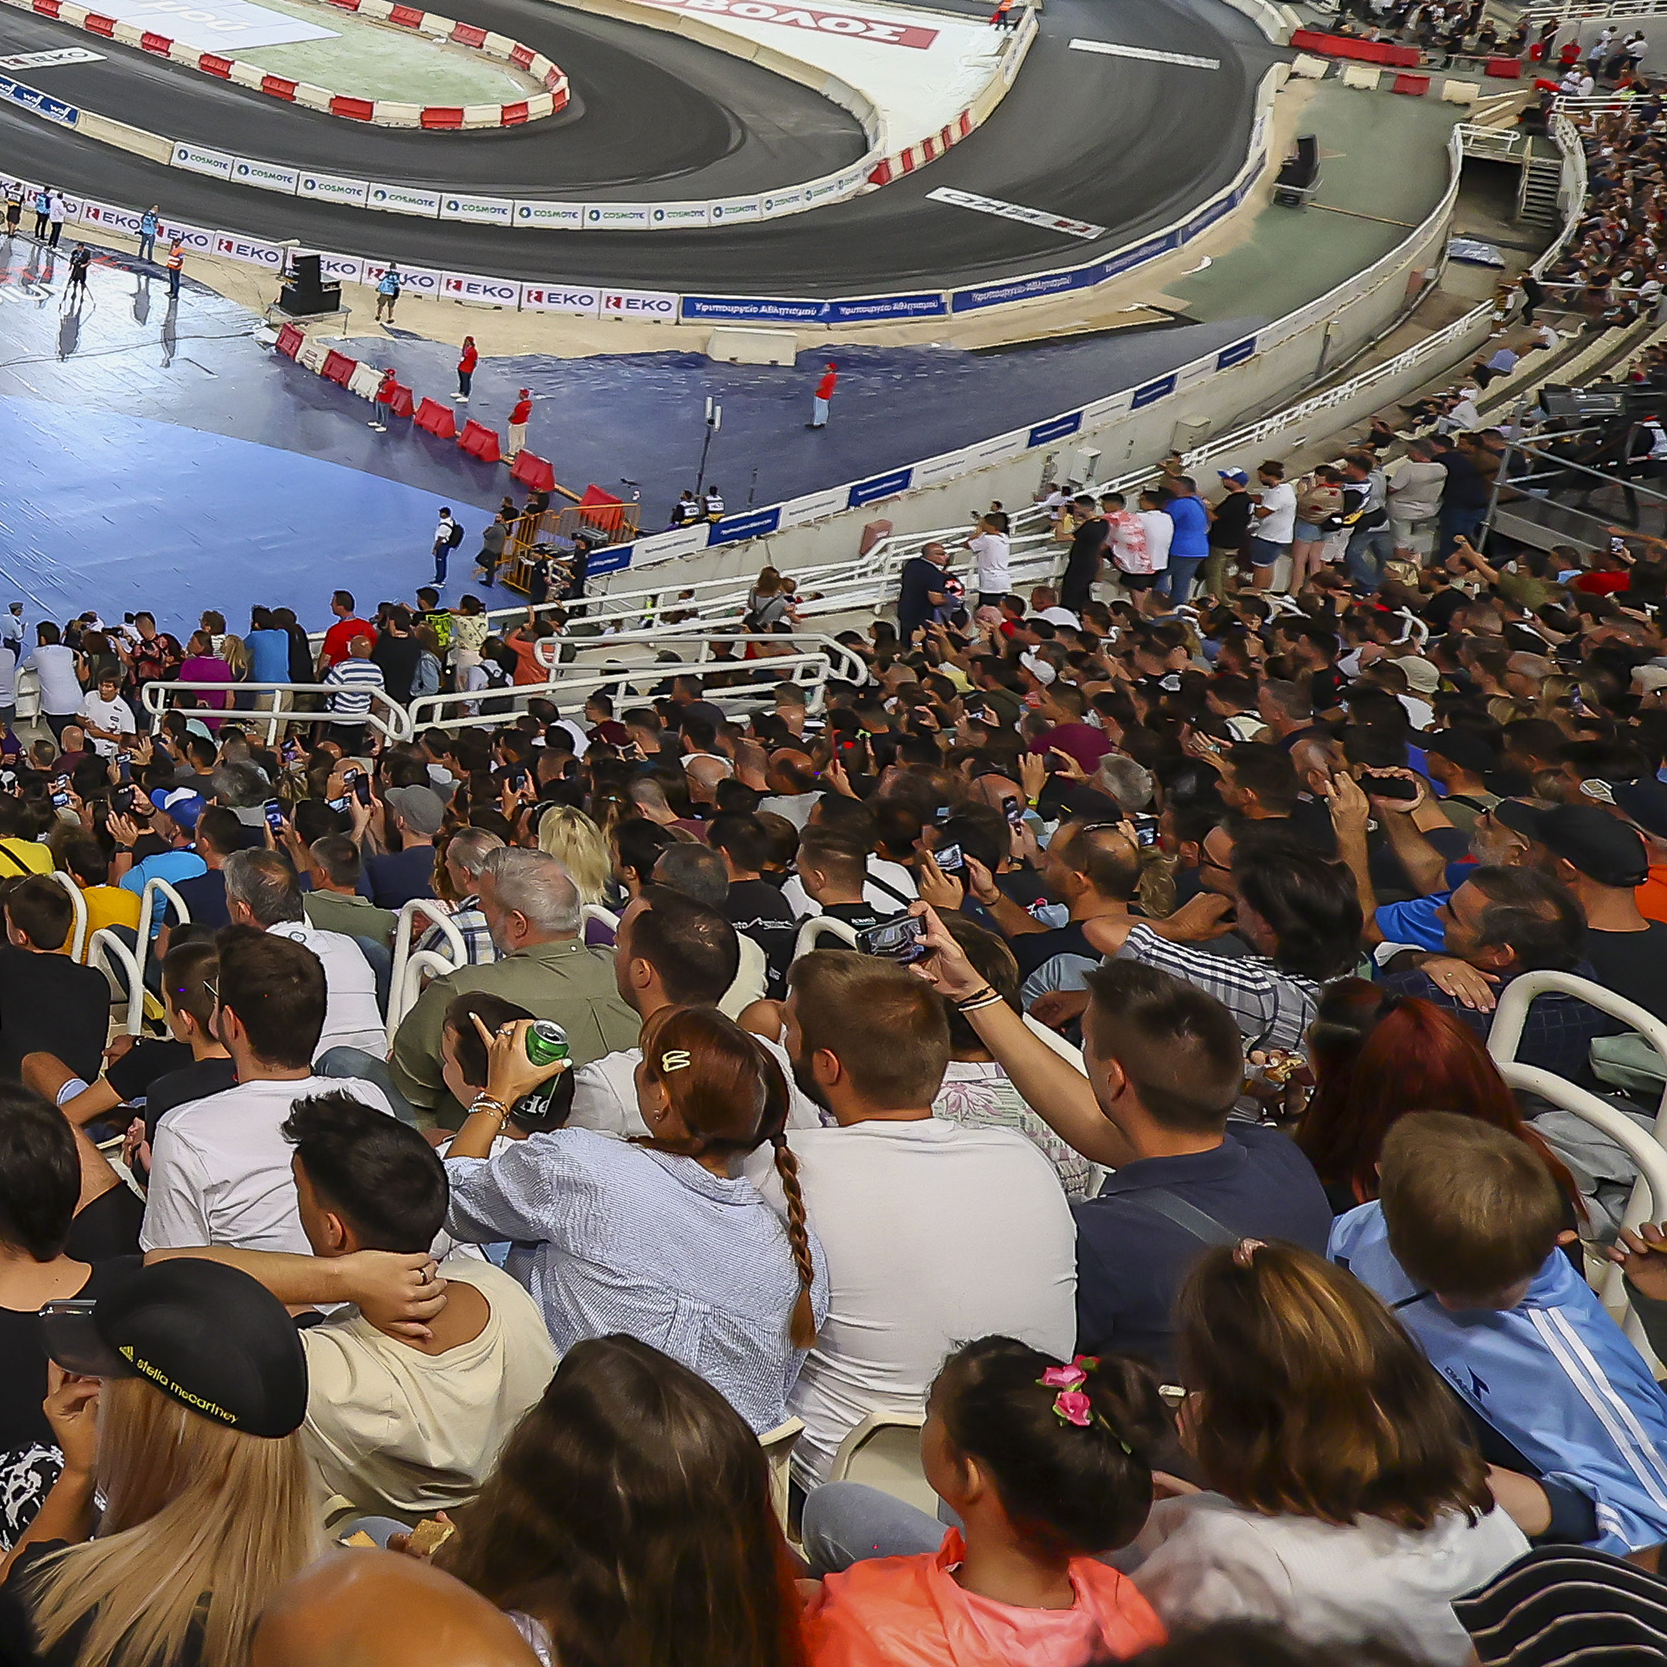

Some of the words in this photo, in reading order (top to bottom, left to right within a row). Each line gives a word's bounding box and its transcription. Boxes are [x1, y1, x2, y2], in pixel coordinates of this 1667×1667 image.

[190, 154, 228, 170] COSMOTE
[251, 169, 293, 184] COSMOTE
[319, 183, 363, 196] COSMOTE
[389, 194, 435, 208] COSMOTE
[462, 203, 508, 215] COSMOTE
[534, 210, 578, 218] COSMOTE
[668, 210, 705, 218] COSMOTE
[103, 212, 140, 230] EKO
[168, 230, 208, 246] EKO
[236, 246, 279, 262] EKO
[466, 284, 514, 299] EKO
[548, 293, 594, 306] EKO
[626, 299, 672, 312] EKO
[134, 1359, 169, 1398] stella
[170, 1382, 239, 1426] mccartney
